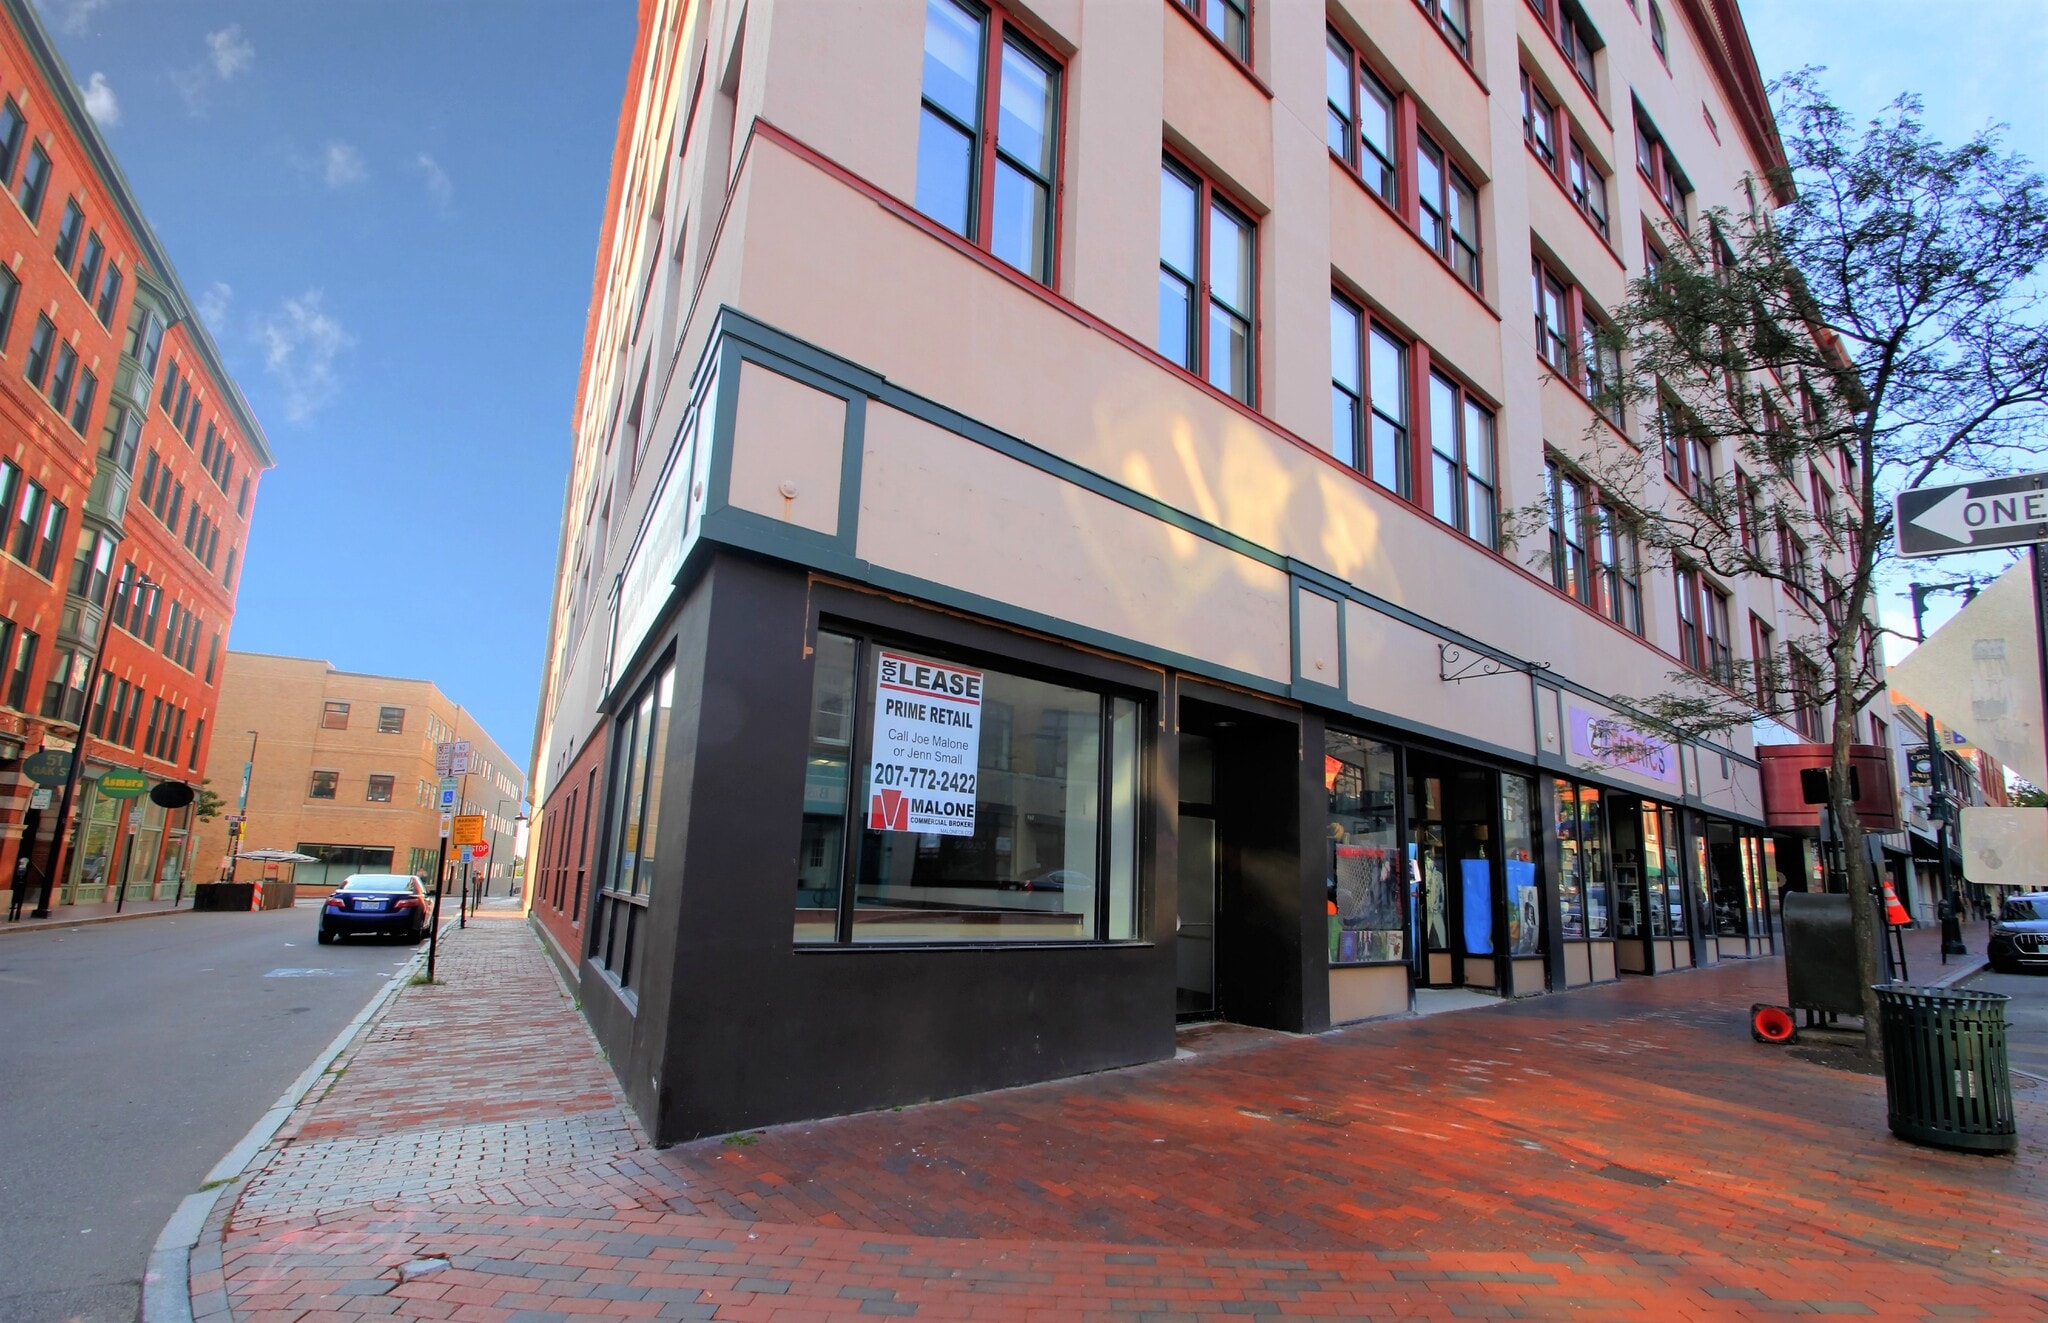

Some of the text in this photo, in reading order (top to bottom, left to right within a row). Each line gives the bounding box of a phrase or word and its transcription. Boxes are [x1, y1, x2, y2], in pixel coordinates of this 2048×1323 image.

[1964, 494, 2047, 526] ONE
[881, 660, 897, 683] FOR
[899, 663, 980, 698] LEASE
[886, 698, 973, 728] PRIME RETAIL
[888, 728, 969, 750] Call Joe Malone
[46, 754, 63, 766] 51
[893, 747, 963, 765] or Jenn Small
[31, 766, 70, 777] OAK S
[102, 776, 144, 787] Asmara
[874, 762, 976, 794] 207-772-2422
[911, 798, 974, 817] MALONE
[910, 817, 973, 828] COMMERCIAL BROKERS
